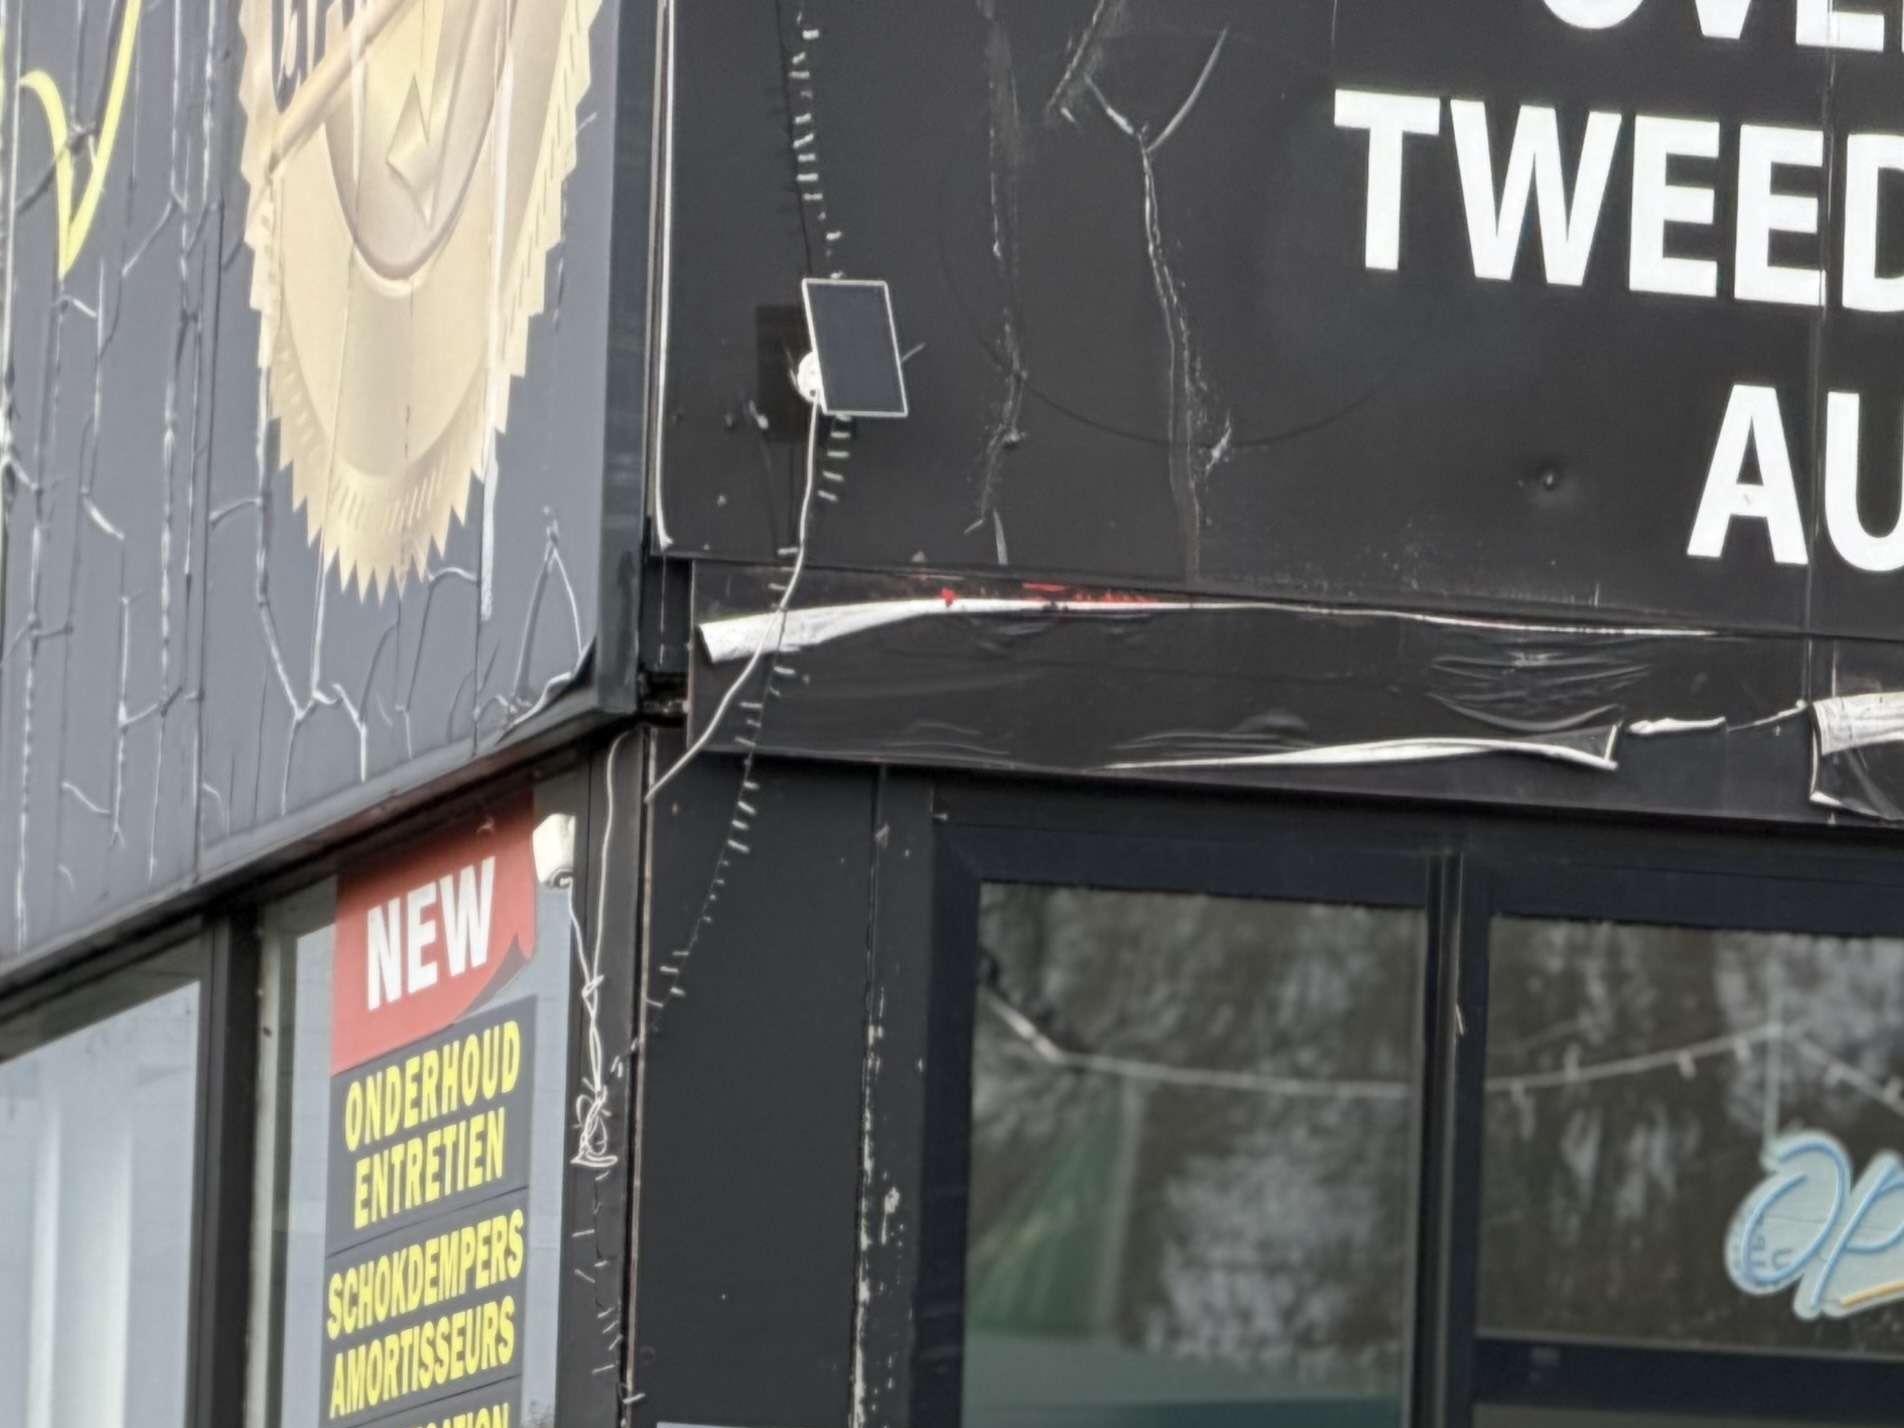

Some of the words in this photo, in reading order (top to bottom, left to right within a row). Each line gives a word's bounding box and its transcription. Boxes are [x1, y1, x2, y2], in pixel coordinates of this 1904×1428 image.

[366, 856, 495, 1011] NEW
[344, 1020, 521, 1152] ONDERHOUD
[354, 1107, 506, 1230] ENTRETIEN
[327, 1208, 524, 1339] SCHOKDEMPERS
[329, 1296, 515, 1420] AMORTISSEURS
